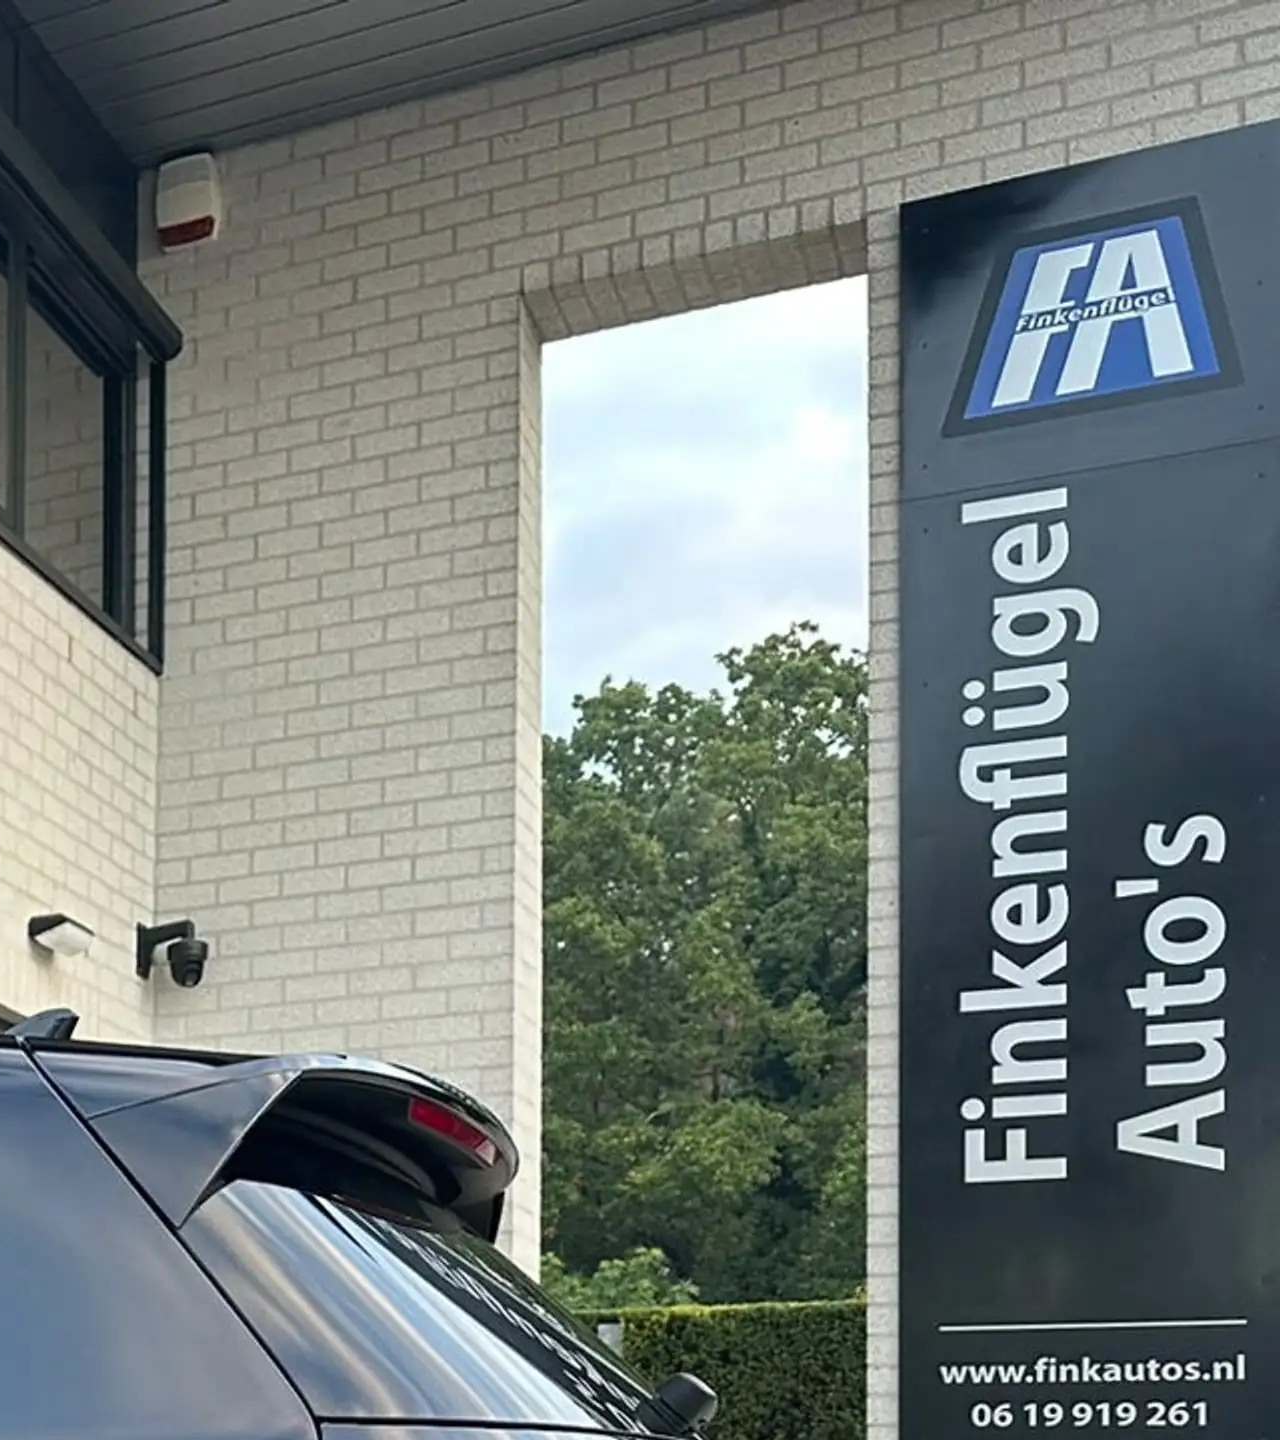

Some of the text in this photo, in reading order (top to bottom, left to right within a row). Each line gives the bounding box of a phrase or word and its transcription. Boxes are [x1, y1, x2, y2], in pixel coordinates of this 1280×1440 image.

[959, 487, 1099, 1184] Finkenflügel
[1116, 813, 1226, 1172] Auto's
[939, 1354, 1247, 1385] www.finkautos.nl
[971, 1400, 1209, 1428] 06 19 919 261
